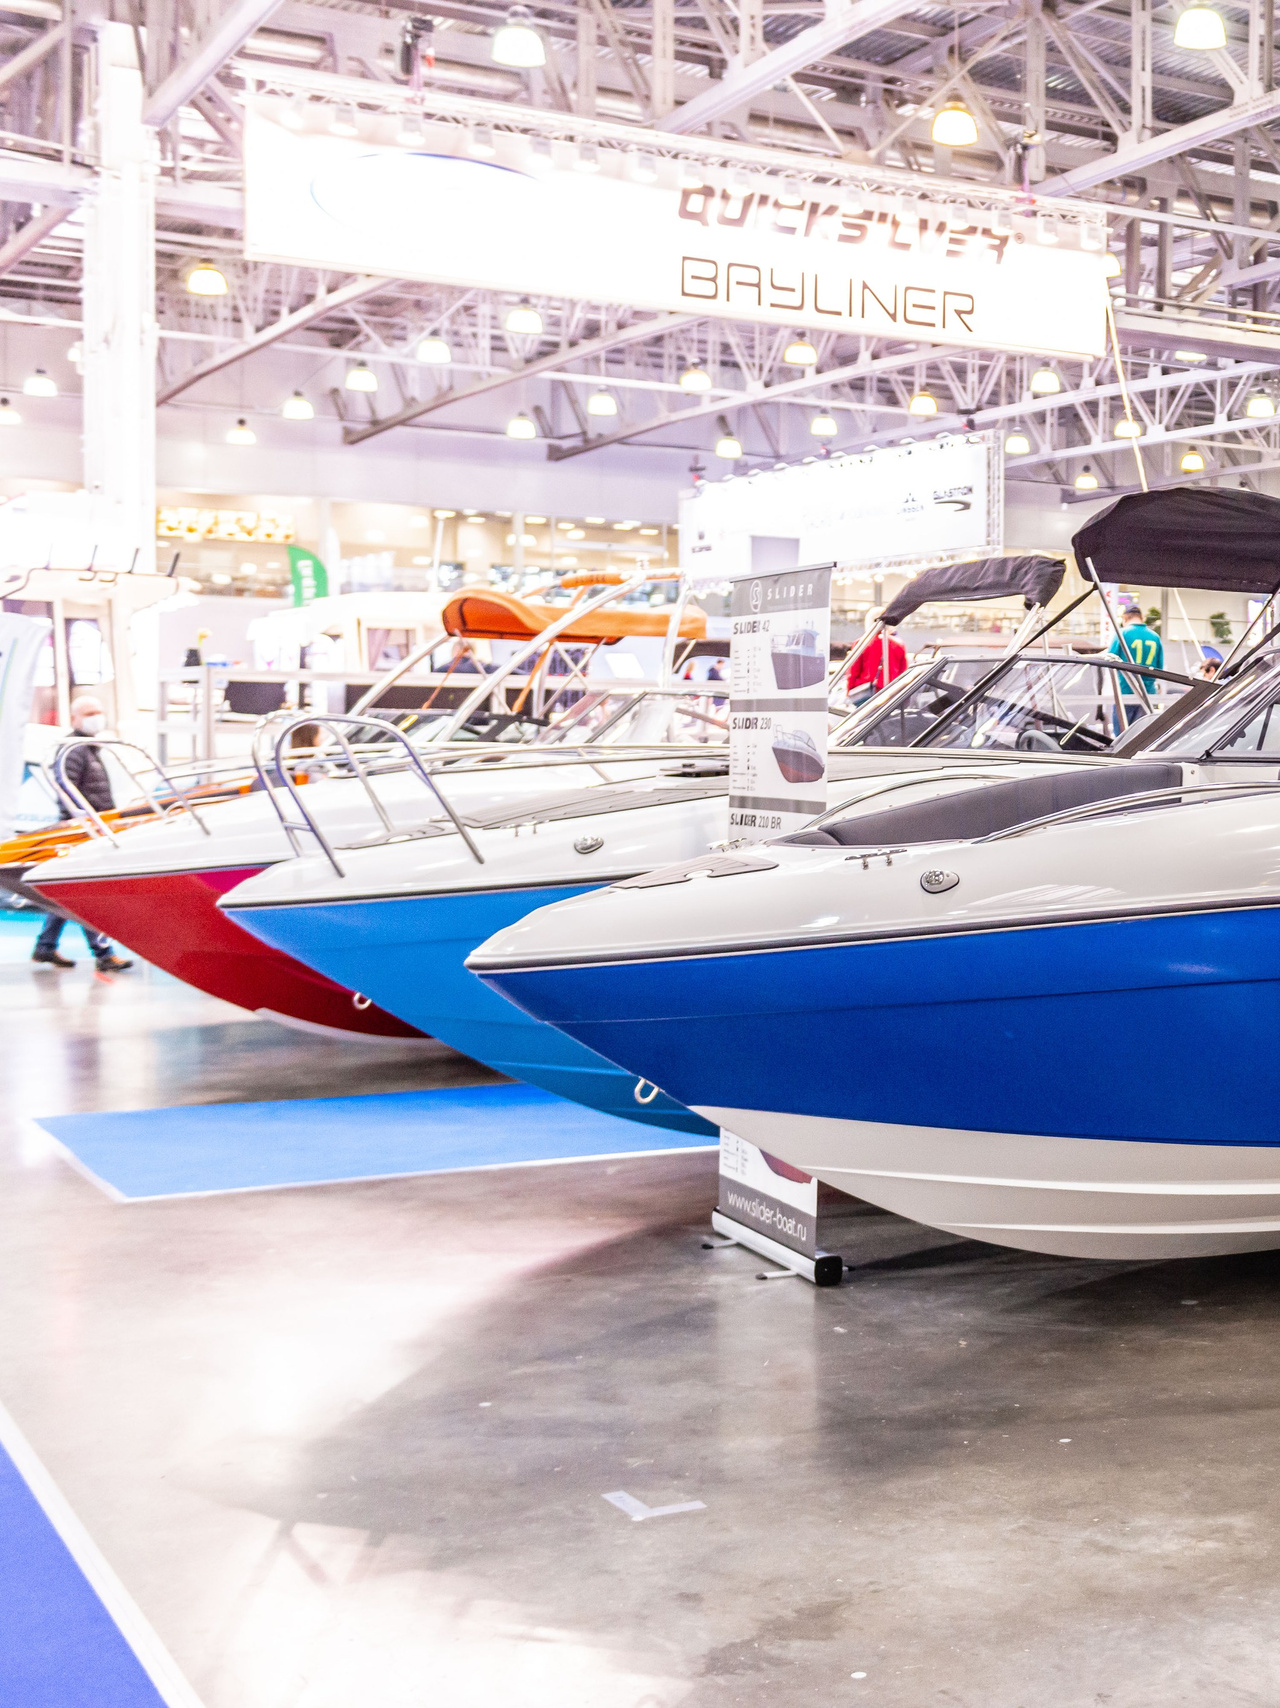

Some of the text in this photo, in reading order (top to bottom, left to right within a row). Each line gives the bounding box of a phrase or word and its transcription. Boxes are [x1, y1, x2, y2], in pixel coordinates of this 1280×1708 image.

[678, 183, 1008, 264] QUCKSLVER
[681, 255, 975, 332] BAYLINER
[767, 583, 813, 600] SLIDER
[1131, 639, 1157, 665] 17
[760, 717, 772, 730] 230
[730, 813, 782, 830] SLIDER 210 BR
[727, 1190, 808, 1242] www.slider-boat.ru
